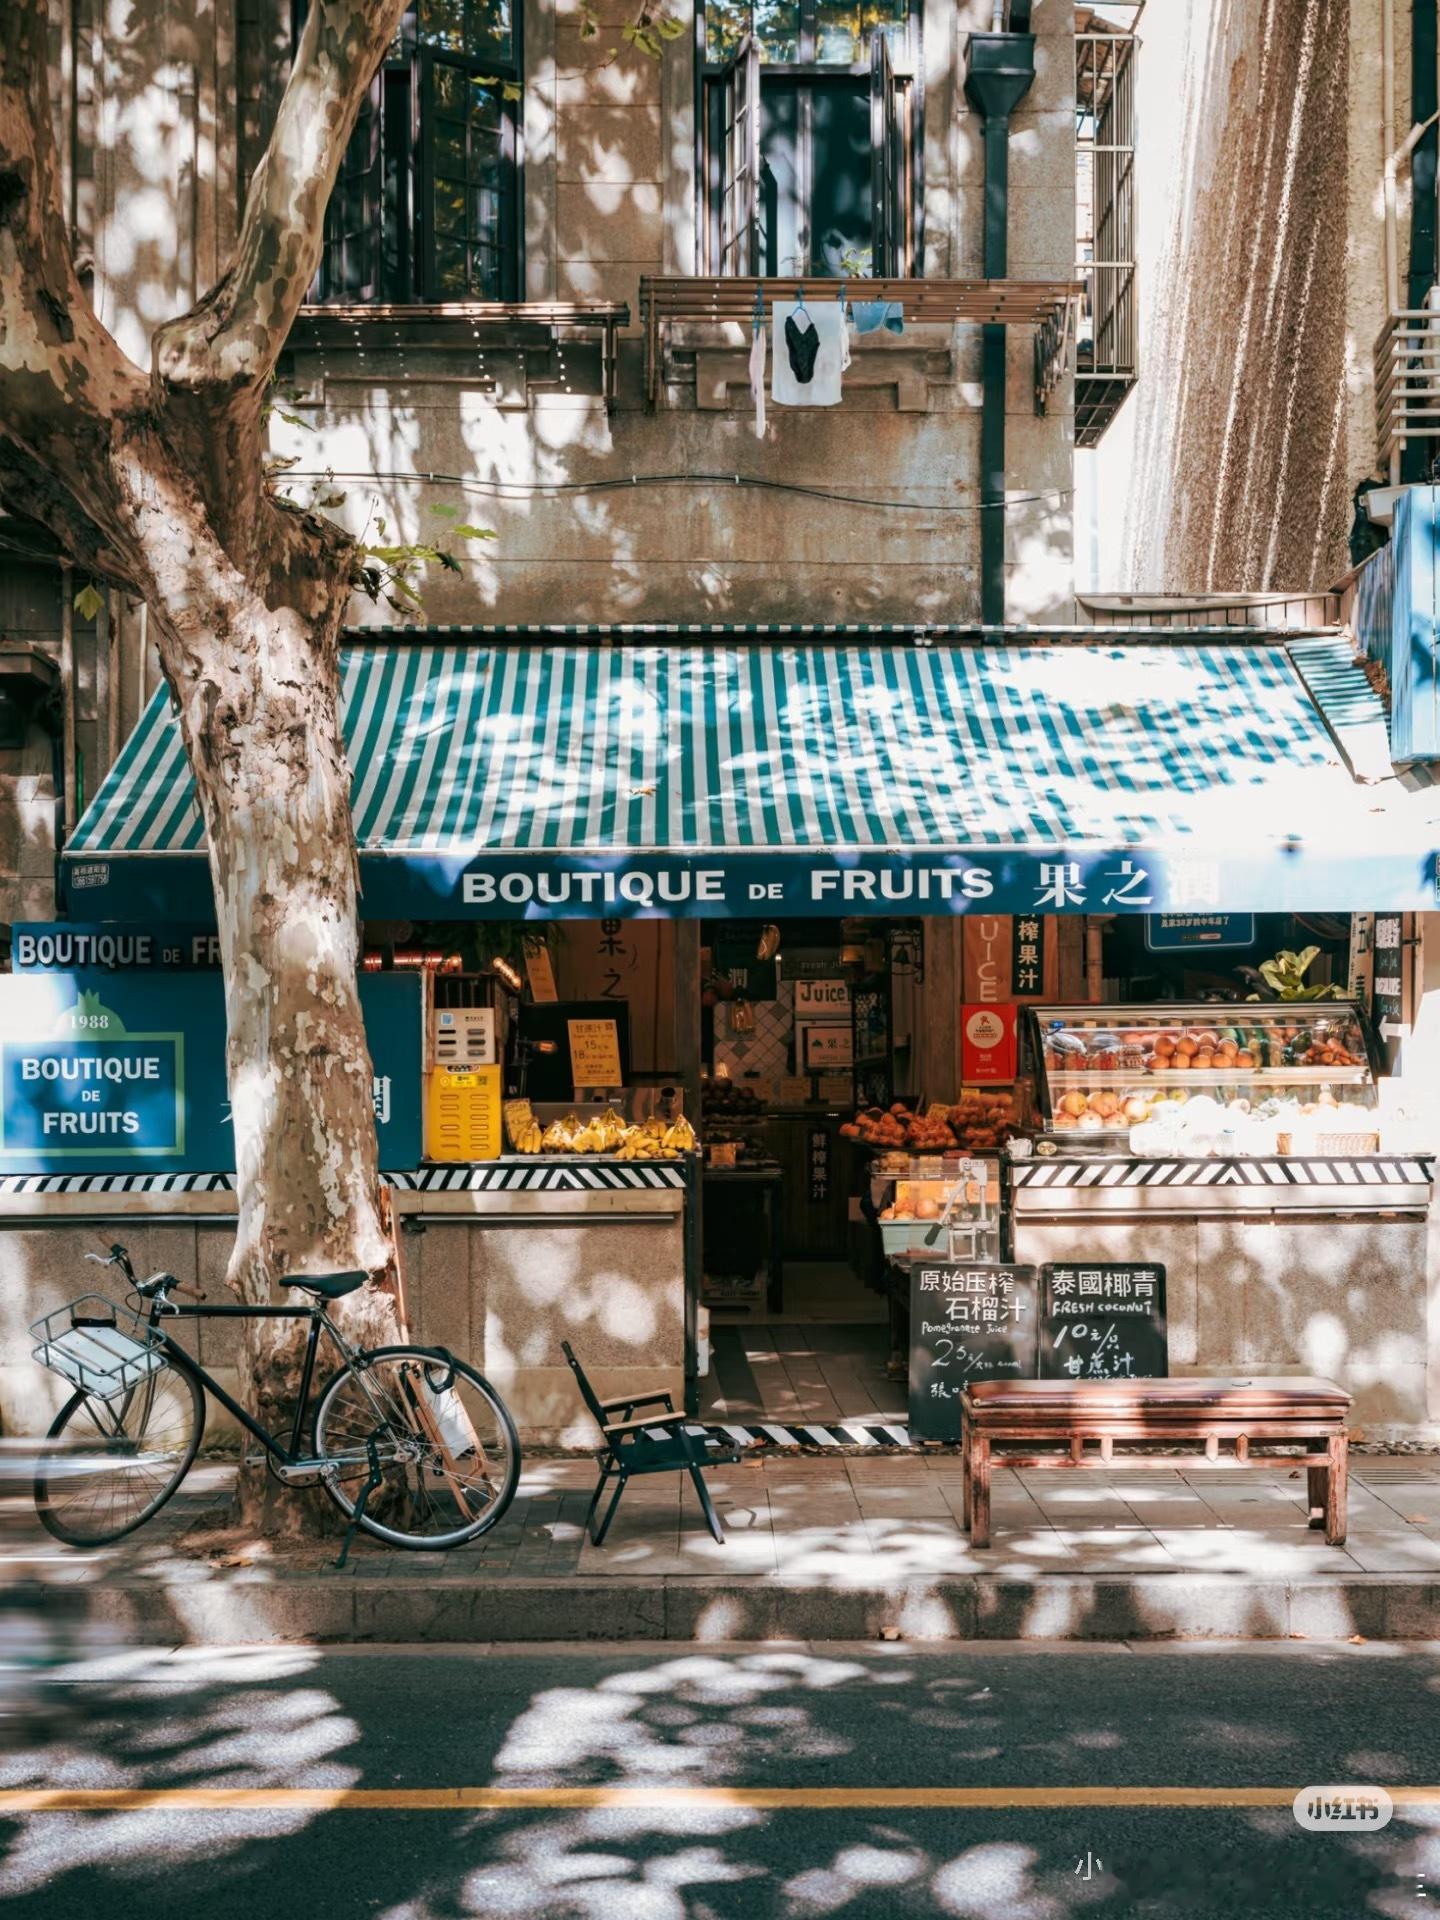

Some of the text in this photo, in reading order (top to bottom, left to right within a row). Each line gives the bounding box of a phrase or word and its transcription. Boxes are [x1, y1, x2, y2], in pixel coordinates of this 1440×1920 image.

[462, 868, 994, 907] BOUTIQUE DE FRUITS
[18, 935, 151, 968] BOUTIQUE
[163, 949, 181, 963] DE
[977, 914, 999, 1002] UICE
[1018, 914, 1039, 989] 榨果汁
[801, 981, 847, 1002] Juice
[70, 1015, 109, 1029] 1988
[22, 1058, 160, 1083] BOUTIQUE
[82, 1090, 101, 1102] DE
[43, 1112, 140, 1134] FRUITS
[920, 1270, 1015, 1295] 原始压榨
[1052, 1270, 1156, 1298] 泰國椰青
[945, 1296, 1026, 1322] 石榴汁
[1052, 1302, 1094, 1316] FRESH
